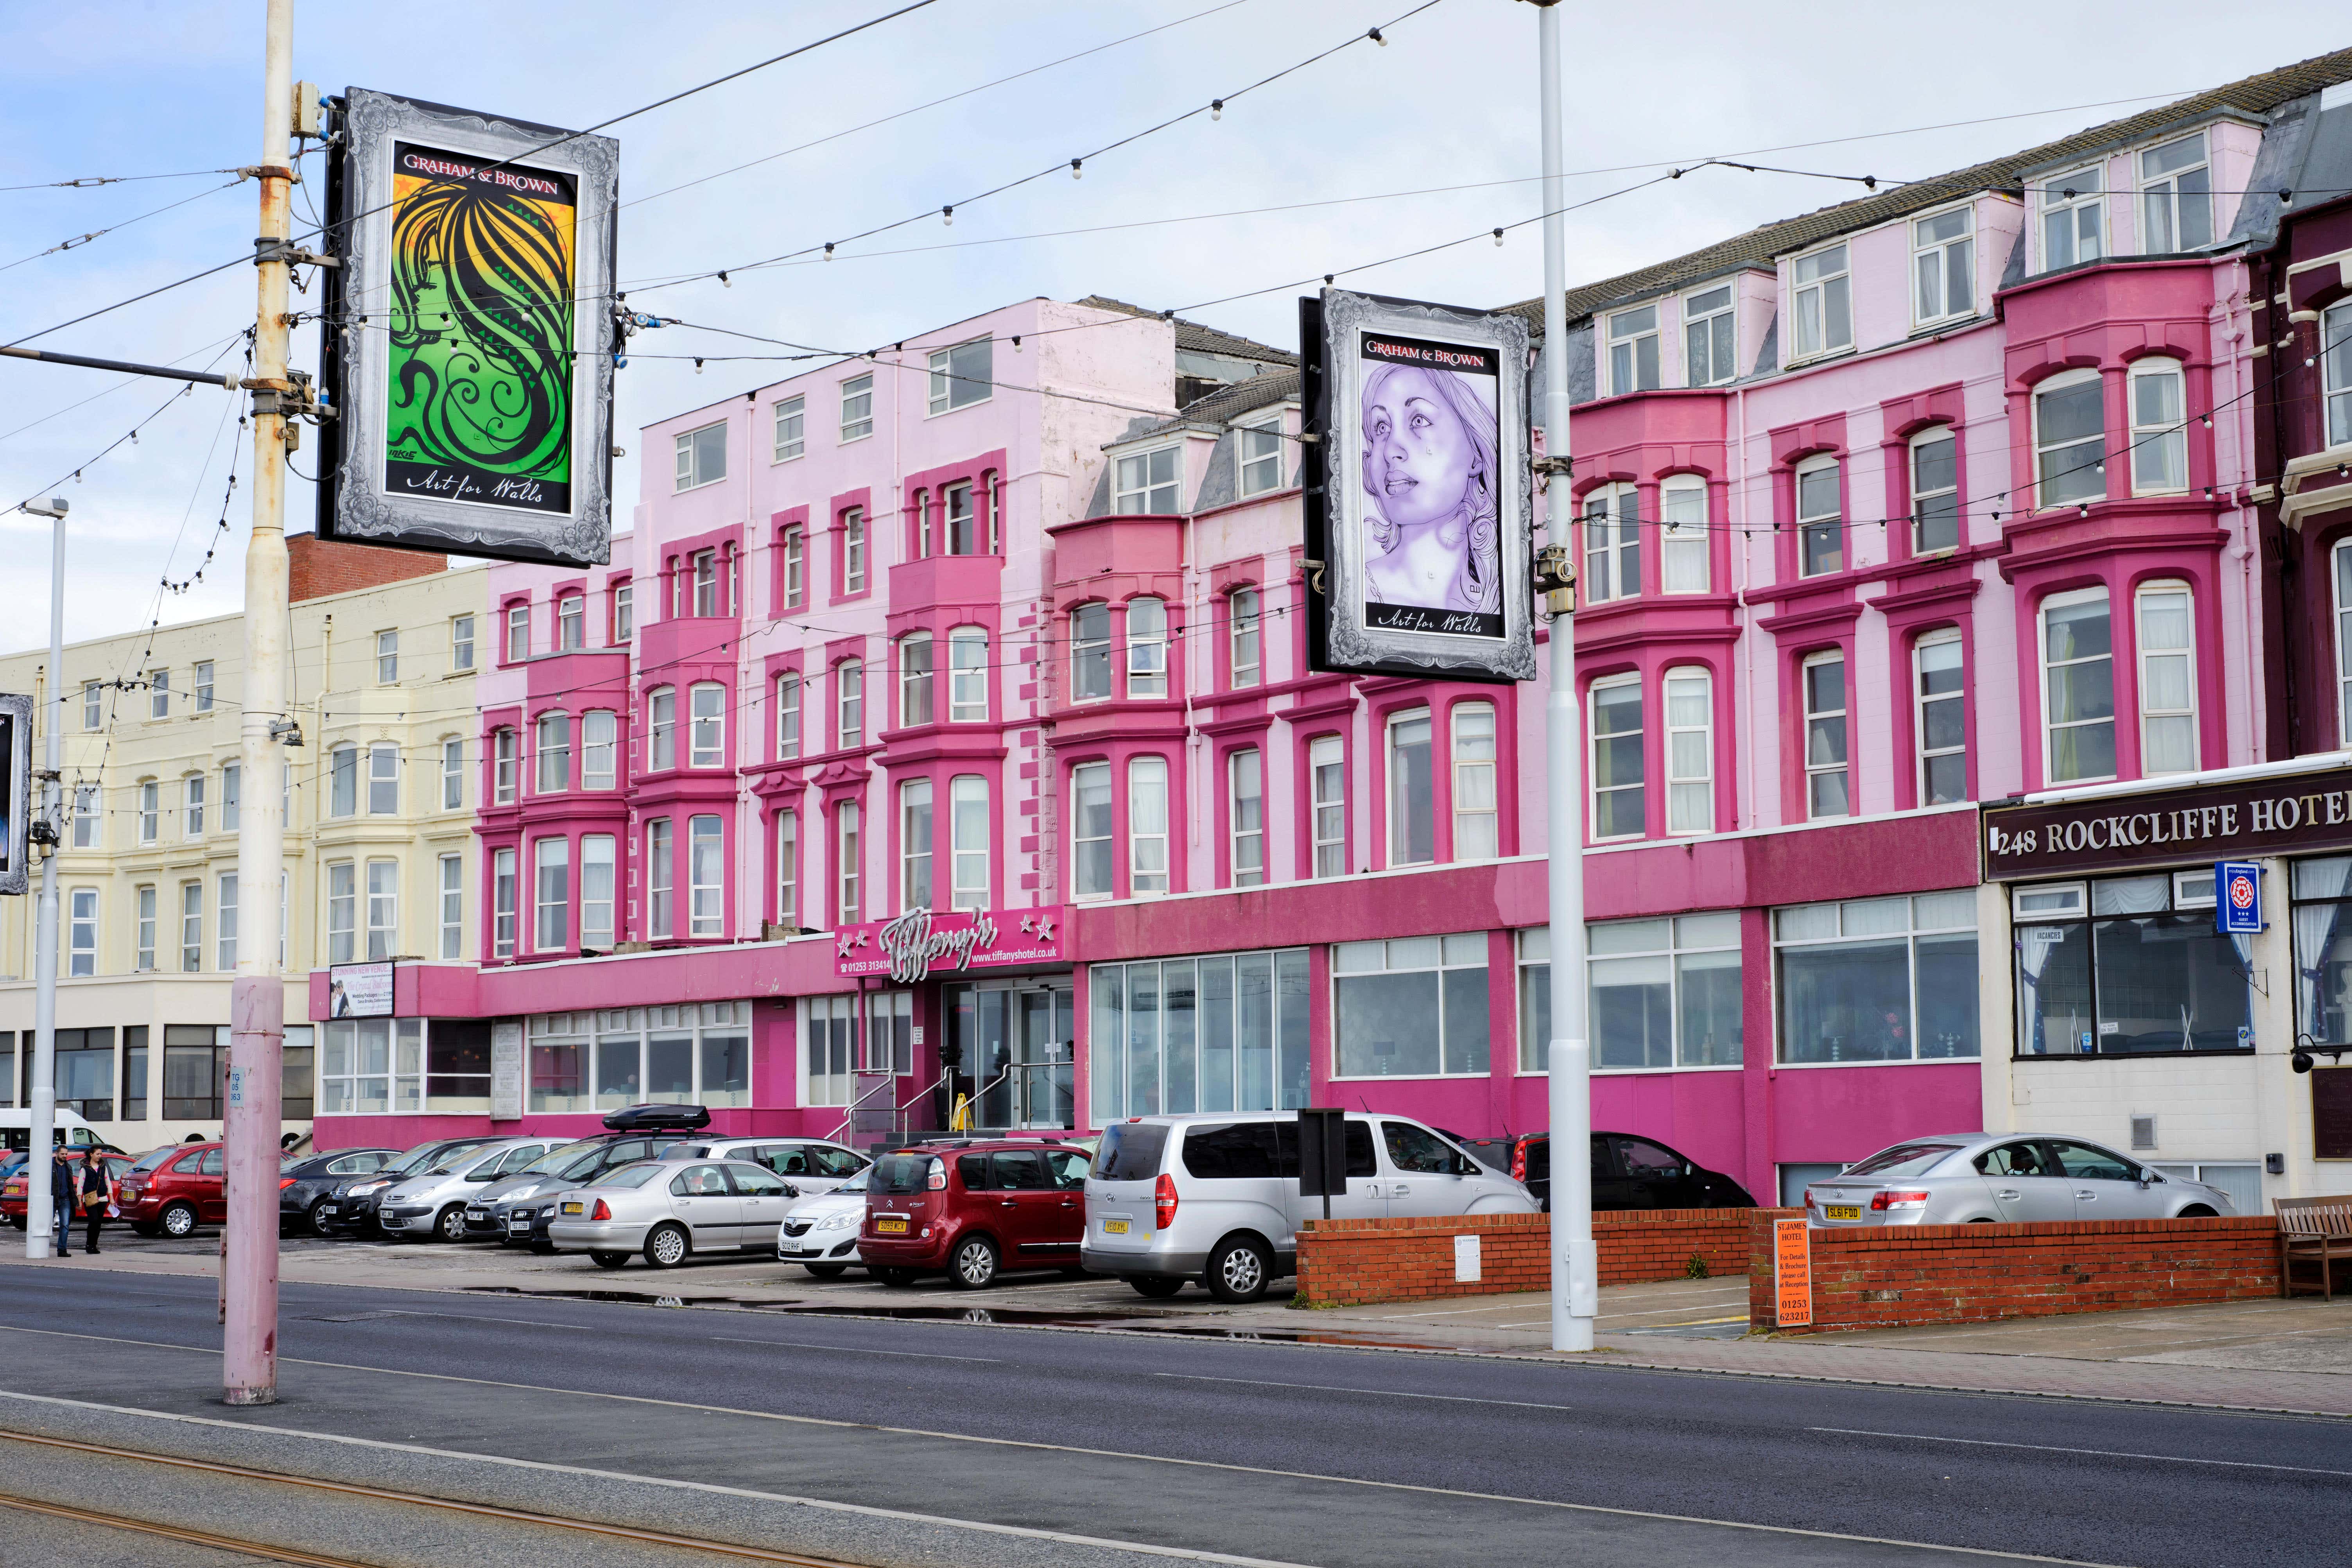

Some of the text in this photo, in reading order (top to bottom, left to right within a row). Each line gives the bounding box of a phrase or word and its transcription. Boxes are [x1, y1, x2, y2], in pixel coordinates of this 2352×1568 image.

[404, 154, 558, 194] GRAHAM & BROWN
[1366, 340, 1484, 367] GRAHAM & BROWN
[407, 470, 543, 502] Art for Walls
[1378, 609, 1481, 633] Art for Walls
[1998, 830, 2037, 856] 248
[2045, 804, 2241, 854] ROCKCLIFFE
[879, 904, 997, 983] Tiffany's
[332, 967, 357, 976] STUNNING
[358, 966, 369, 974] NEW
[848, 946, 1057, 972] 01253 313414 www.tiffanyshotel.co.uk
[1830, 1208, 1857, 1217] SL61 FDD
[881, 1221, 904, 1230] SD59 WCX
[1107, 1222, 1126, 1231] YE10 XYL
[1782, 1299, 1806, 1308] 01253
[1780, 1312, 1809, 1321] 623217
